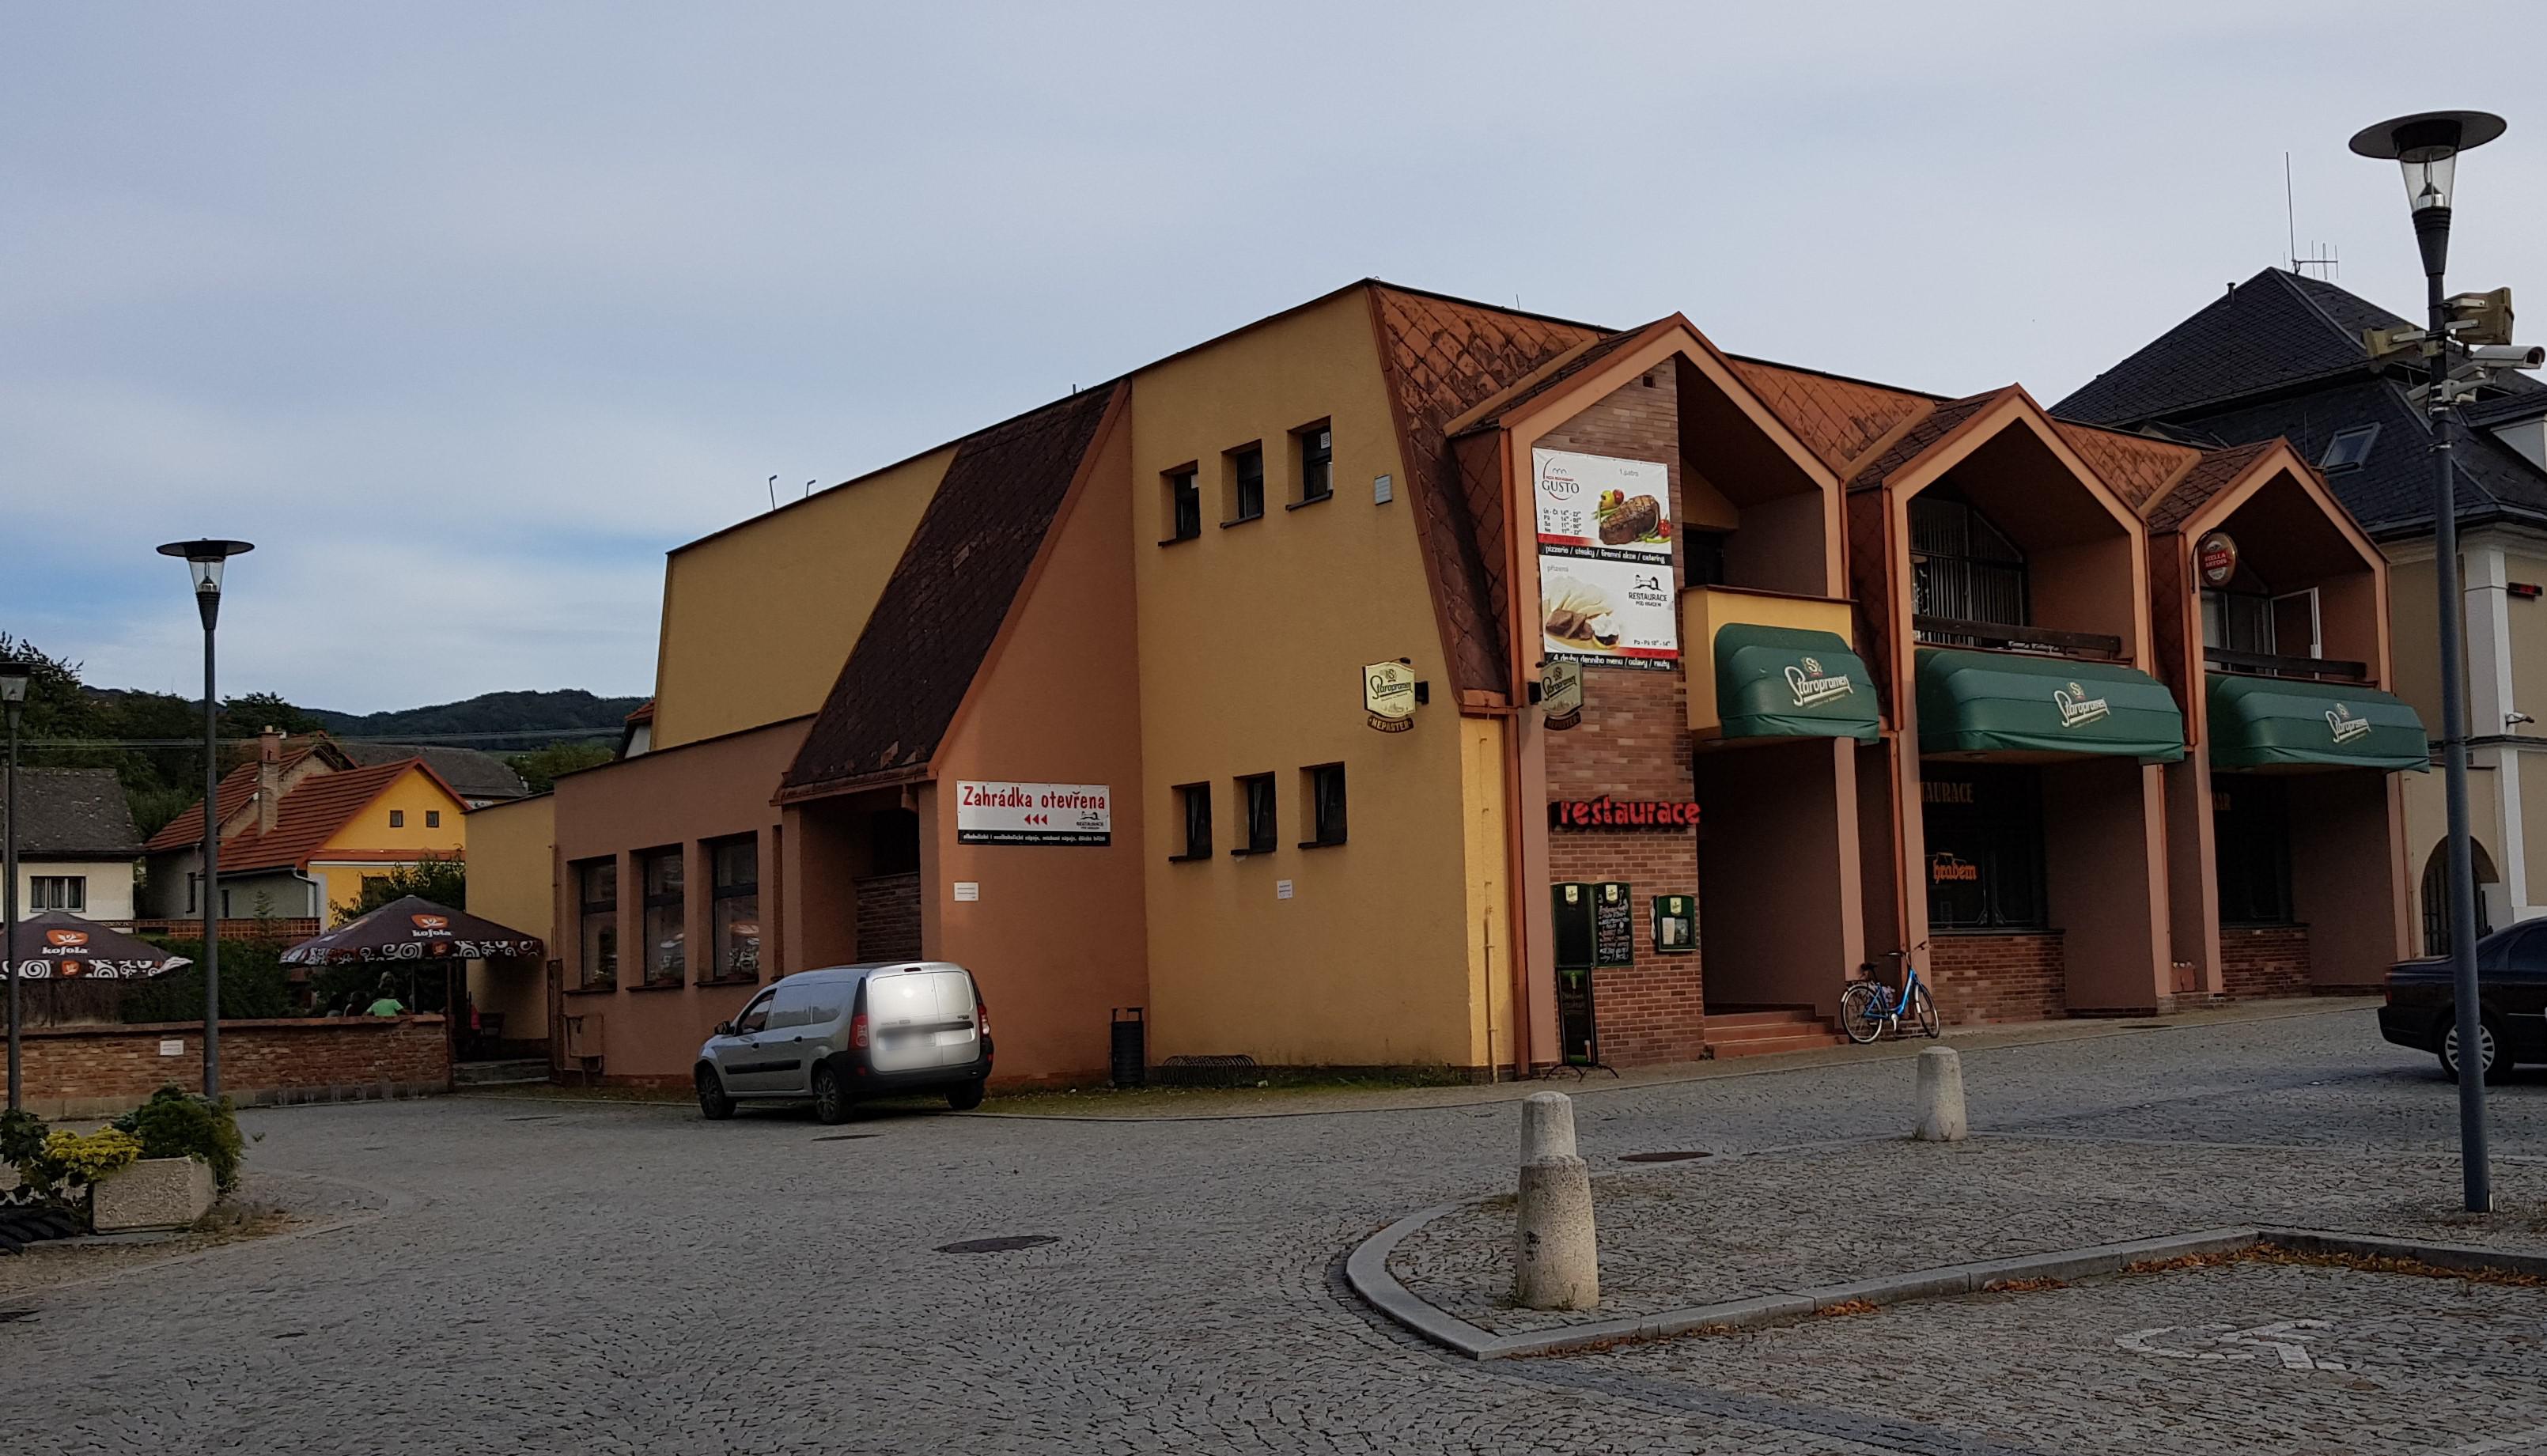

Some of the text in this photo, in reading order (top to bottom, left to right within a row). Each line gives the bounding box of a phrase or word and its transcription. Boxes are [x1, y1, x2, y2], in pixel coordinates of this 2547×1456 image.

[1542, 479, 1580, 494] GUSTO
[1628, 592, 1667, 602] RESTAURACE
[1369, 675, 1413, 700] Staropramen
[1784, 666, 1854, 707] Staropramen
[2053, 690, 2110, 728] Staropramen
[963, 785, 1106, 810] Zahrádka otevřena
[1561, 795, 1701, 825] restaurace
[411, 928, 452, 939] kofola
[41, 946, 89, 956] kofola
